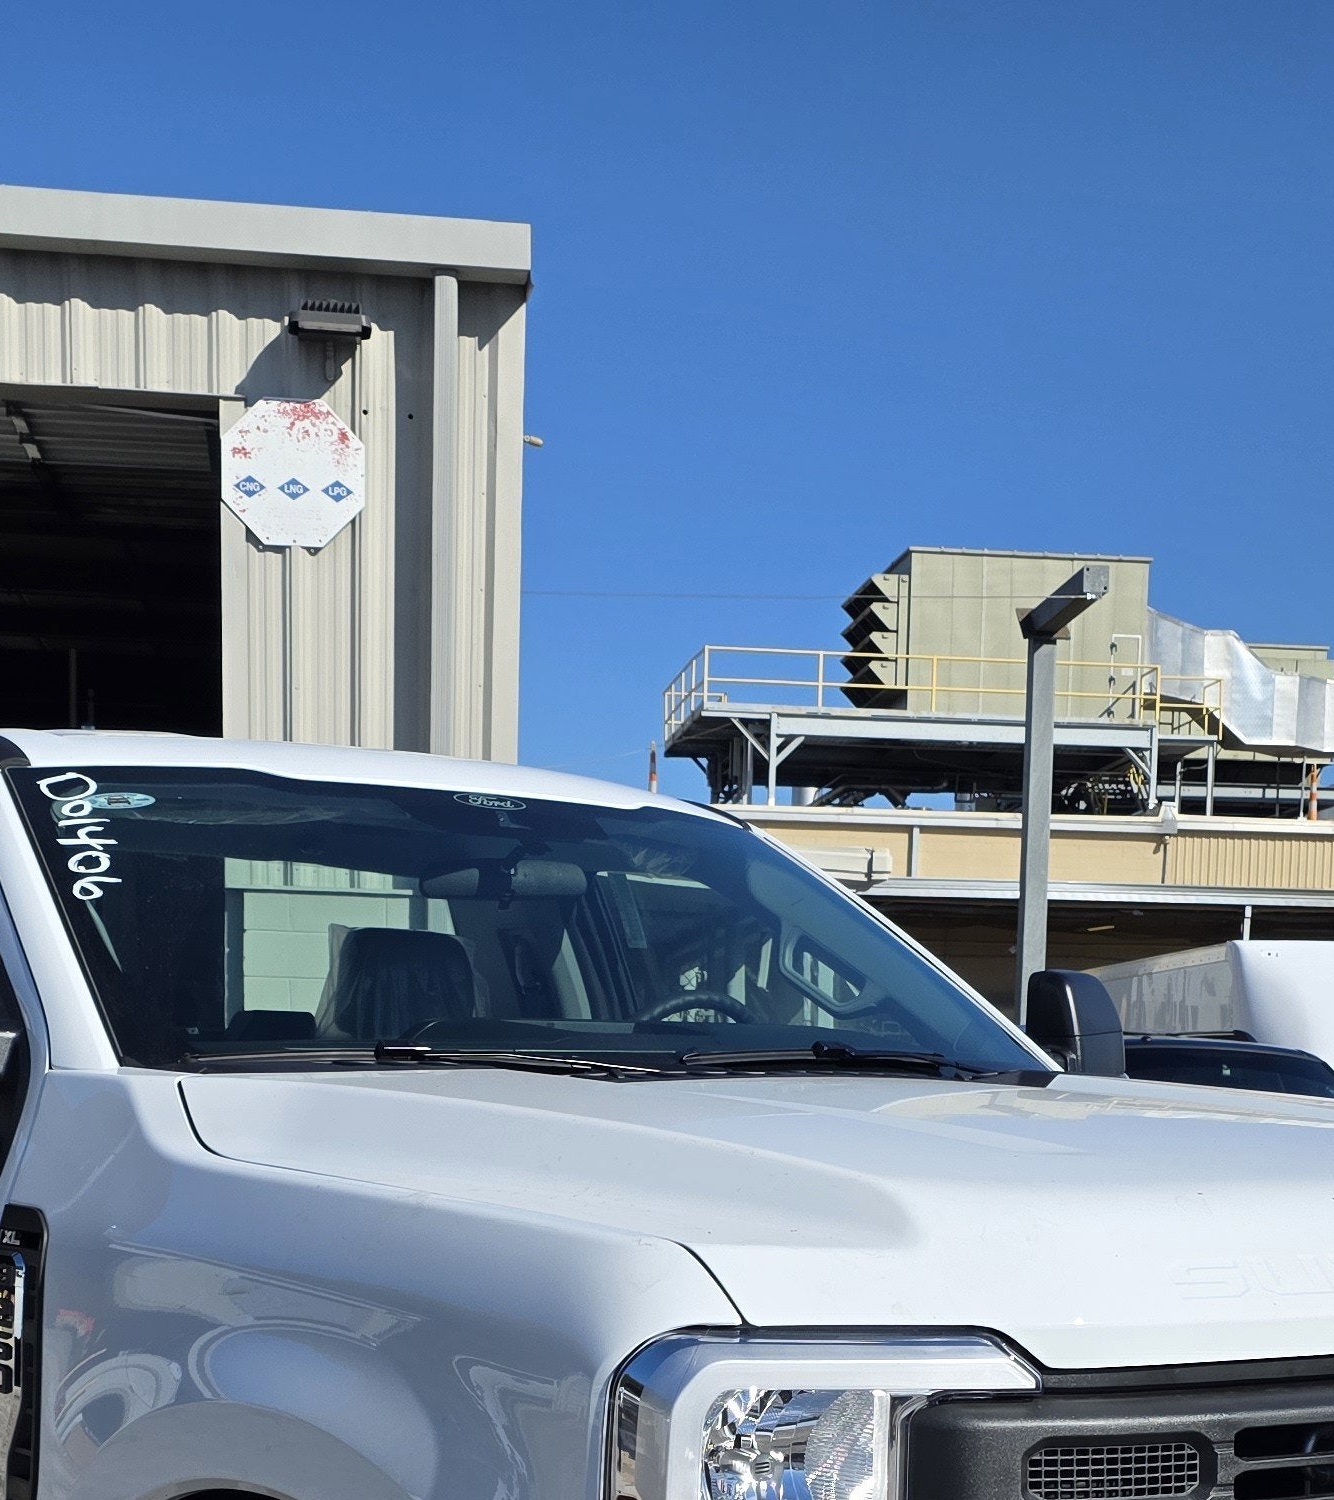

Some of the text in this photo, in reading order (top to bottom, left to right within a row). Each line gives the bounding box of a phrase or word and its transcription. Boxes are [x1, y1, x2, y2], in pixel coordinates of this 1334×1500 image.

[239, 481, 261, 492] CNG
[284, 484, 304, 494] LNG
[328, 486, 348, 496] LPG
[468, 794, 514, 808] Ford
[2, 1229, 21, 1246] XL
